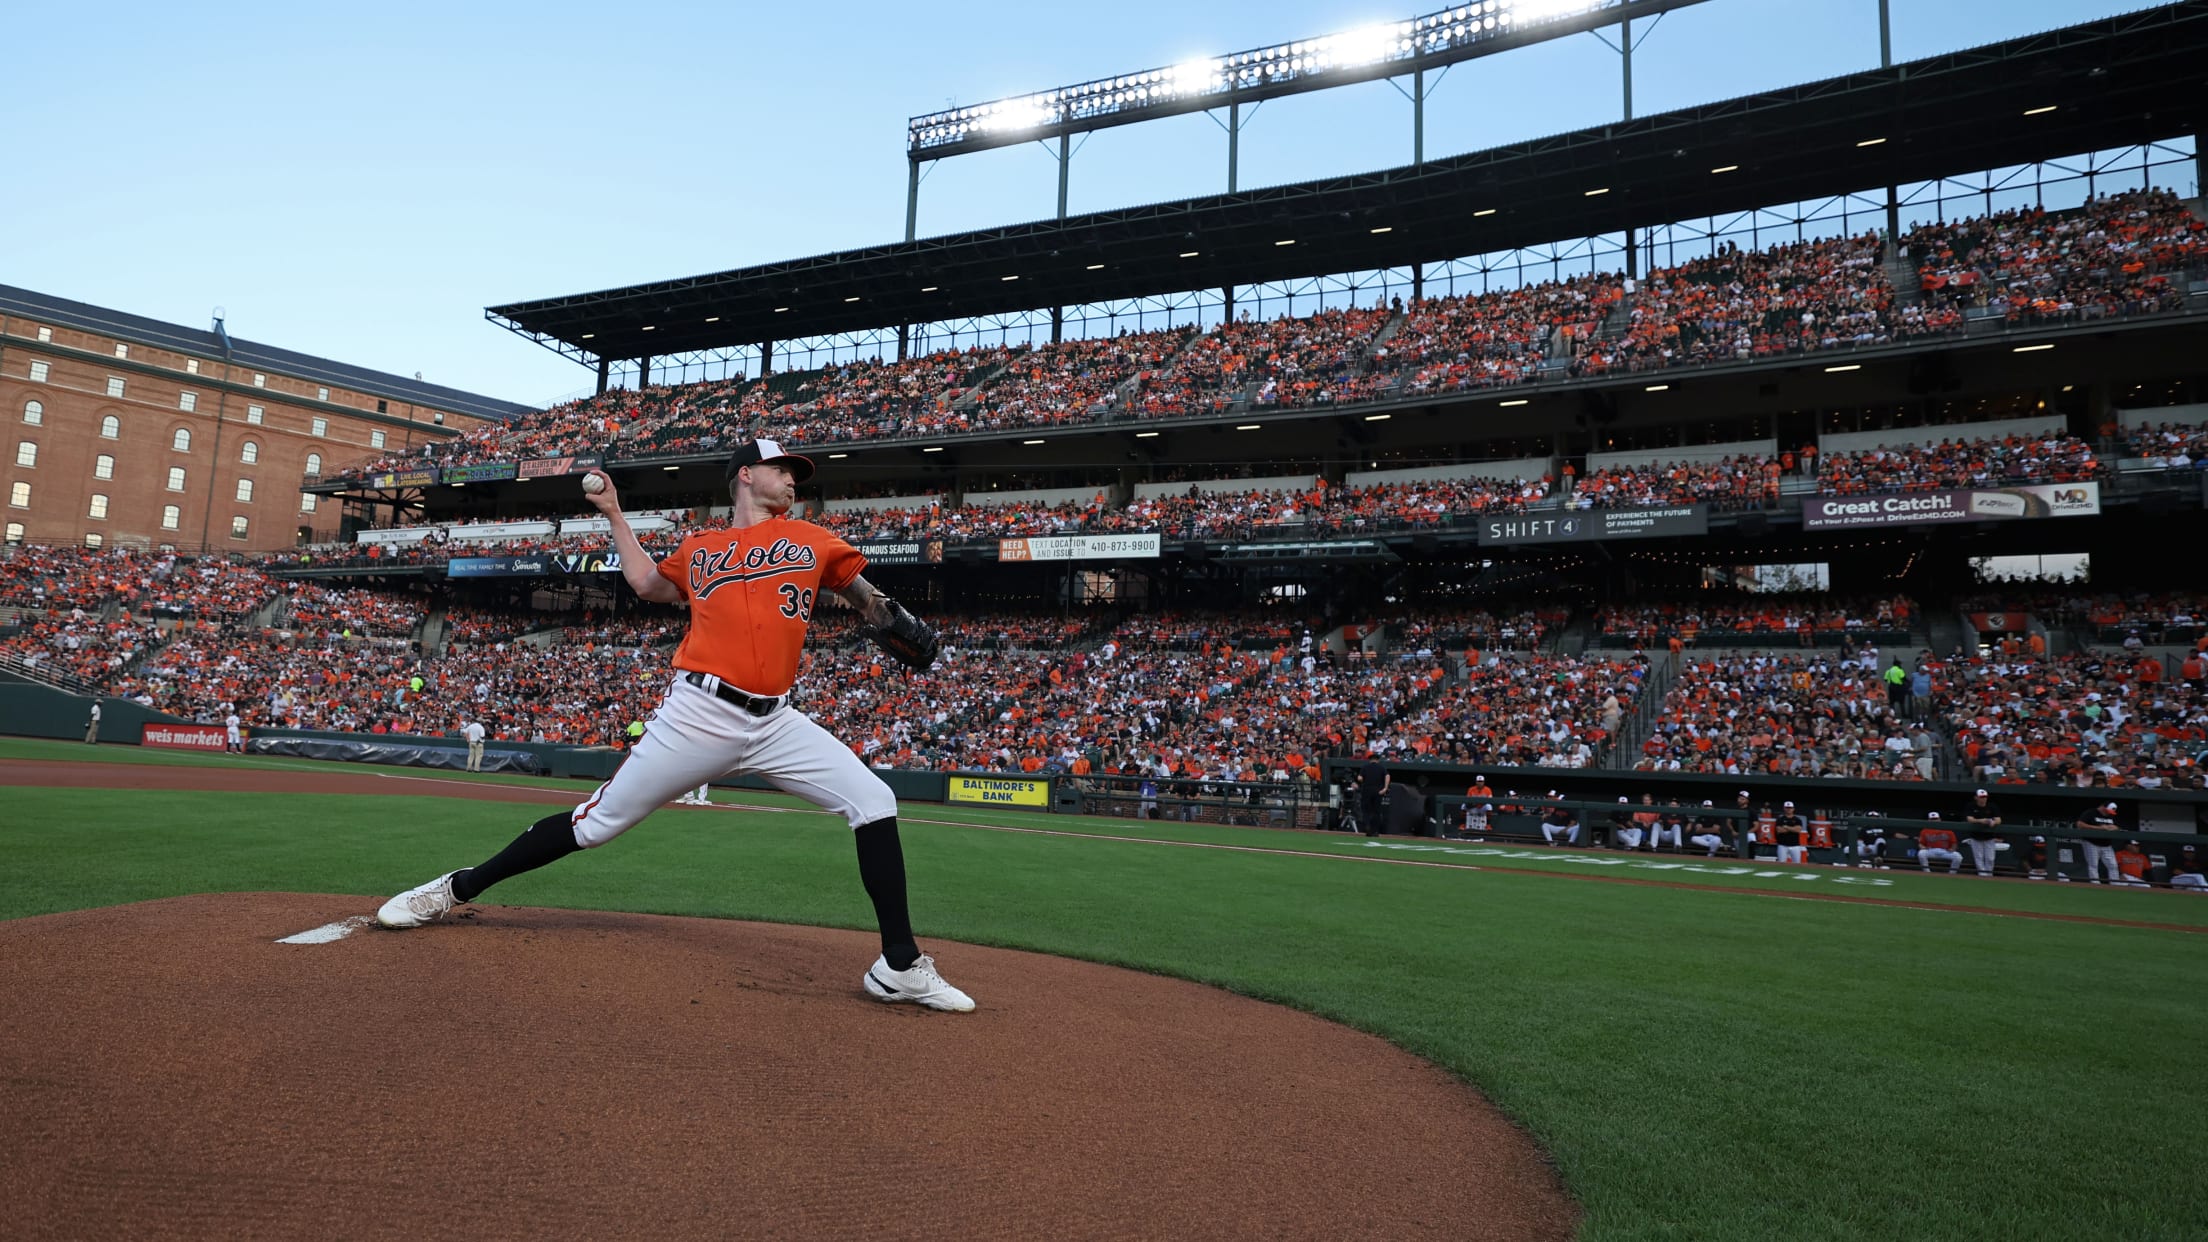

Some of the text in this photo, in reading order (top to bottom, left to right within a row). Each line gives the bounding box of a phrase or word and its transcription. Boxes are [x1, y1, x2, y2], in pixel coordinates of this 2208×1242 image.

[1822, 494, 1952, 516] Great Catch!
[1605, 508, 1692, 520] EXPERIENCE THE FUTURE
[1617, 518, 1655, 527] PAYMENTS
[1808, 518, 1823, 526] Get
[1490, 520, 1556, 538] SHIFT
[861, 544, 888, 555] FAMOUS
[888, 543, 919, 554] SEAFOOD
[1002, 540, 1023, 549] NEED
[1030, 538, 1156, 552] TEXT LOCATION 410-873-9900
[1002, 550, 1027, 560] HELP?
[1036, 548, 1086, 558] AND ISSUE TO
[689, 537, 816, 593] Orioles
[778, 582, 813, 624] 39
[145, 728, 224, 747] weis markets
[963, 779, 1035, 792] BALTIMORE'S
[982, 791, 1014, 802] BANK
